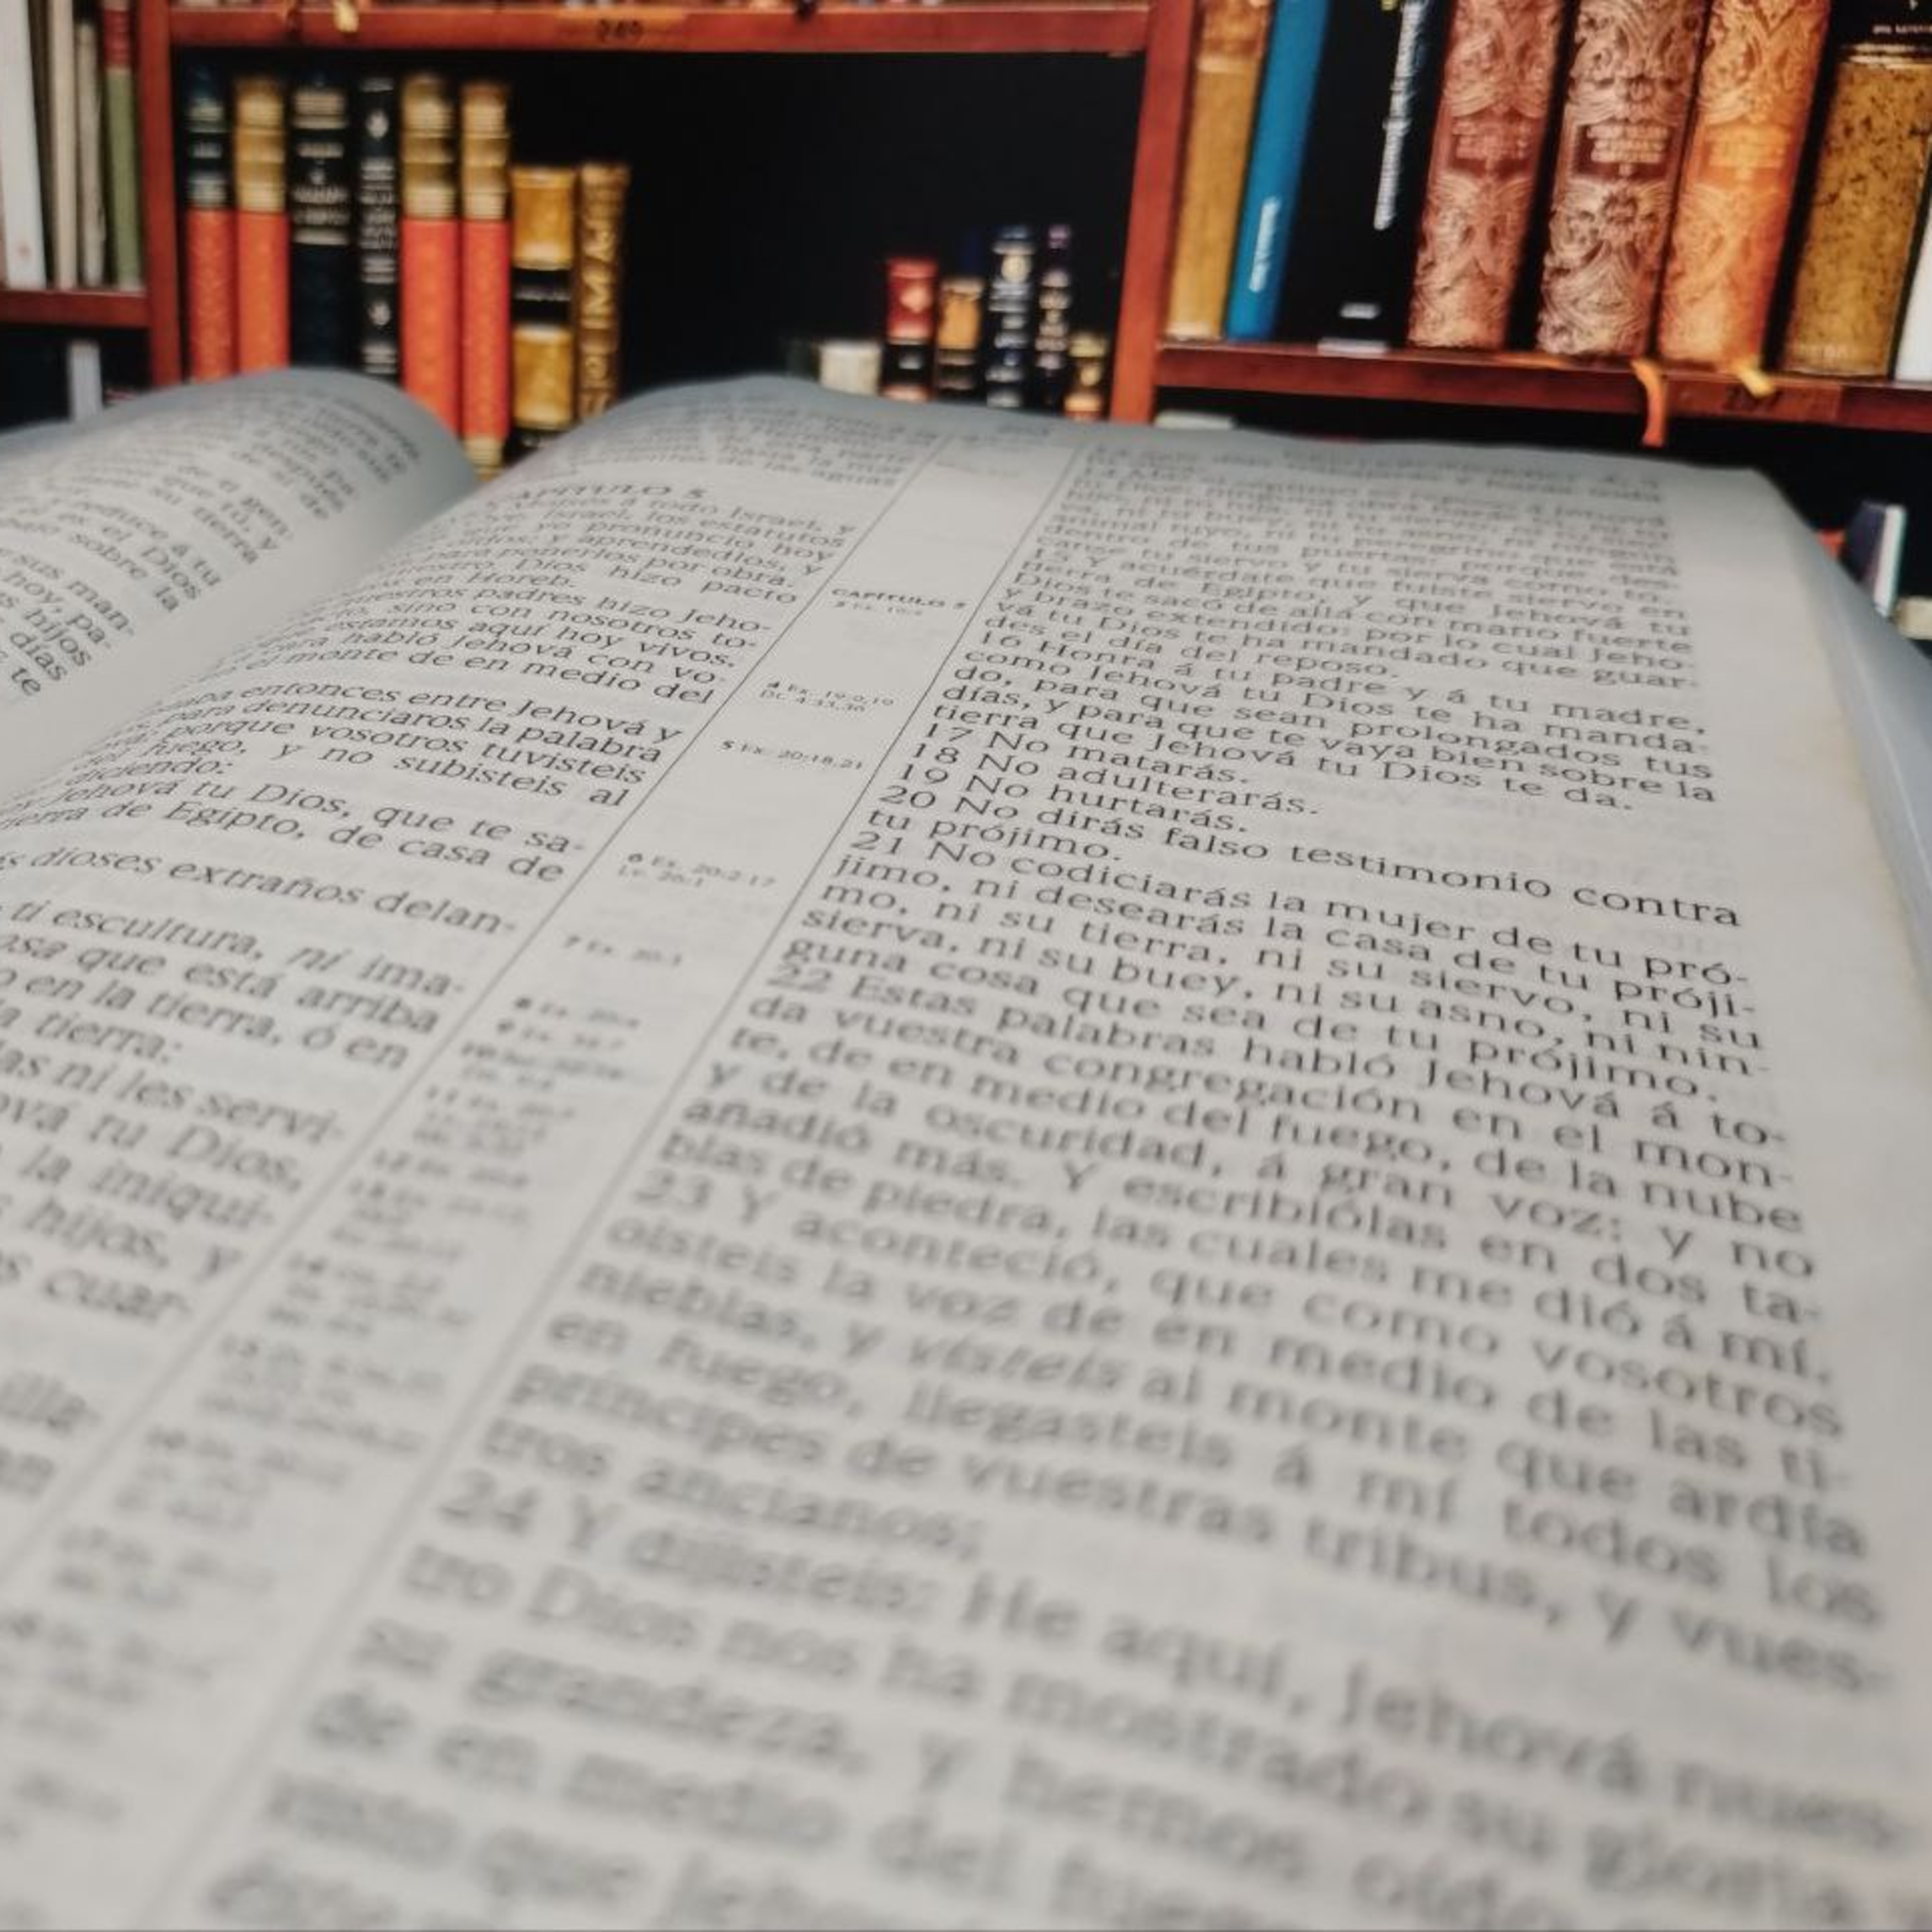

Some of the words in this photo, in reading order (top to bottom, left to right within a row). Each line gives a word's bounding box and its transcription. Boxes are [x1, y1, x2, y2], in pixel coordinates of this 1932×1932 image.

[71, 531, 149, 582] sobre
[153, 587, 180, 612] la
[140, 545, 201, 601] Dios
[193, 558, 222, 587] tu
[24, 607, 92, 668] hijos
[470, 603, 532, 617] con
[547, 609, 696, 641] nosotros
[712, 633, 757, 649] to-
[474, 585, 585, 607] padres
[600, 596, 671, 617] hizo
[678, 609, 772, 633] Jeho-
[1014, 572, 1091, 594] Dios
[1103, 587, 1133, 599] te
[1235, 602, 1278, 616] de
[1365, 611, 1435, 627] con
[1448, 620, 1560, 639] mano
[1574, 628, 1693, 653] fuerte
[9, 629, 69, 681] días
[408, 647, 454, 666] de
[465, 654, 508, 671] en
[522, 663, 641, 690] medio
[654, 684, 714, 705] del
[451, 634, 573, 660] Jehová
[587, 652, 654, 674] con
[468, 621, 546, 638] aquí
[556, 624, 624, 650] hoy
[639, 641, 735, 668] vivos.
[979, 634, 1021, 650] 16
[1039, 641, 1155, 669] Honra
[1215, 665, 1249, 682] tu
[1271, 668, 1386, 696] padre
[1405, 687, 1428, 703] y
[1490, 694, 1528, 712] tu
[10, 666, 42, 696] te
[240, 683, 401, 704] entonces
[408, 688, 507, 712] entre
[513, 698, 647, 737] Jehová
[656, 725, 682, 744] y
[163, 717, 294, 738] porque
[310, 724, 468, 755] vosotros
[482, 741, 647, 786] tuvisteis
[243, 699, 471, 733] denunciaros
[477, 717, 511, 736] la
[517, 727, 662, 763] palabra
[925, 724, 972, 741] 17
[988, 730, 1048, 754] No
[1068, 746, 1248, 784] matarás.
[933, 705, 1039, 728] tierra
[1057, 721, 1135, 747] que
[1149, 734, 1295, 767] Jehová
[1318, 756, 1358, 779] tu
[1382, 761, 1482, 788] Dios
[1504, 776, 1543, 795] te
[1564, 788, 1634, 811] da.
[278, 741, 303, 760] y
[318, 745, 374, 764] no
[393, 753, 568, 797] subisteis
[589, 786, 630, 808] al
[900, 764, 949, 784] 19
[965, 774, 1028, 799] No
[1048, 786, 1247, 833] hurtarás.
[911, 743, 960, 764] 18
[978, 753, 1039, 776] No
[1057, 766, 1321, 815] adulterarás.
[164, 802, 307, 840] Egipto,
[328, 826, 383, 850] de
[399, 838, 489, 866] casa
[508, 855, 565, 882] de
[193, 779, 238, 799] tu
[251, 783, 353, 817] Dios,
[374, 805, 455, 833] que
[469, 817, 511, 841] te
[524, 829, 585, 855] sa-
[868, 810, 911, 832] tu
[928, 818, 1122, 861] prójimo.
[879, 785, 936, 808] 20
[954, 797, 1018, 820] No
[1036, 809, 1145, 840] dirás
[1166, 828, 1269, 861] falso
[1291, 844, 1551, 898] testimonio
[1573, 886, 1741, 927] contra
[169, 862, 366, 904] extraños
[374, 891, 517, 936] delan-
[851, 831, 902, 854] 21
[927, 842, 996, 867] No
[1010, 858, 1251, 909] codiciarás
[1271, 891, 1305, 914] la
[1327, 900, 1477, 942] mujer
[1493, 927, 1553, 954] de
[1573, 942, 1622, 968] tu
[1645, 956, 1748, 986] pró-
[287, 945, 351, 974] ni
[974, 875, 1019, 900] ni
[1036, 886, 1245, 937] desearás
[1267, 917, 1303, 941] la
[1326, 930, 1431, 961] casa
[1454, 950, 1516, 974] de
[1540, 962, 1589, 989] tu
[1613, 980, 1757, 1018] próji-
[25, 972, 86, 1001] en
[91, 980, 137, 1010] la
[343, 1041, 410, 1070] en
[782, 937, 907, 974] guna
[929, 961, 1040, 996] cosa
[1061, 985, 1161, 1019] que
[1182, 1005, 1266, 1030] sea
[1293, 1014, 1358, 1041] de
[1387, 1023, 1438, 1052] tu
[1468, 1038, 1719, 1101] prójimo.
[766, 966, 833, 993] 22
[849, 975, 976, 1016] Estas
[997, 1007, 1215, 1059] palabras
[1426, 1057, 1620, 1119] Jehová
[1712, 1112, 1786, 1146] to-
[748, 994, 807, 1023] da
[835, 1009, 1020, 1065] vuestra
[1043, 1054, 1419, 1124] congregación
[1452, 1107, 1520, 1141] en
[1553, 1124, 1602, 1153] el
[1634, 1137, 1794, 1189] mon-
[636, 1170, 712, 1209] 23
[741, 1182, 780, 1226] Y
[1150, 1264, 1274, 1309] que
[1302, 1291, 1499, 1358] como
[1533, 1336, 1844, 1437] vosotros
[1595, 1582, 1640, 1643] y
